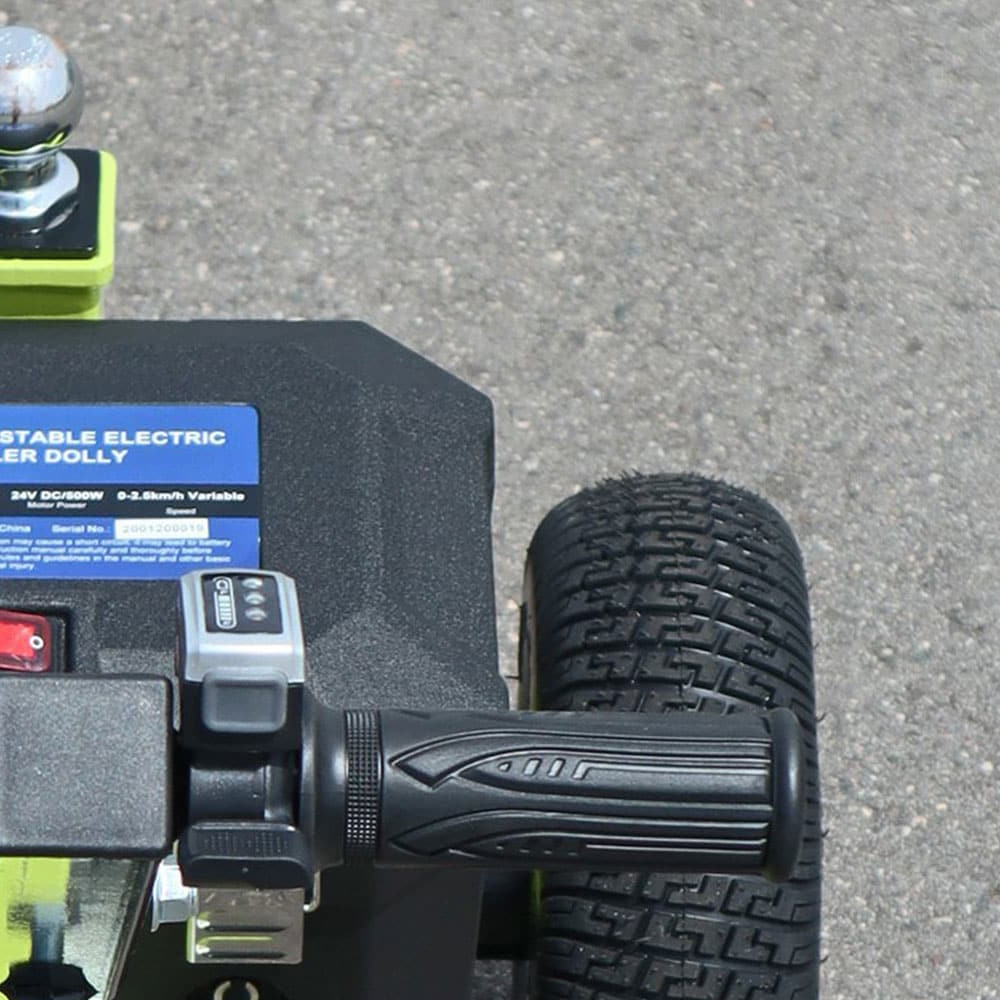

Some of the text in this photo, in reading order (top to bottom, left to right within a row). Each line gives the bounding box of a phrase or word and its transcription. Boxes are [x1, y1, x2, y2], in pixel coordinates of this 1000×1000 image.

[103, 430, 227, 446] ELECTRIC
[44, 449, 129, 464] DOLLY
[10, 490, 37, 500] 24V
[187, 491, 245, 501] Variable
[56, 501, 87, 509] Power
[165, 507, 197, 515] Speed
[52, 524, 85, 533] Serial
